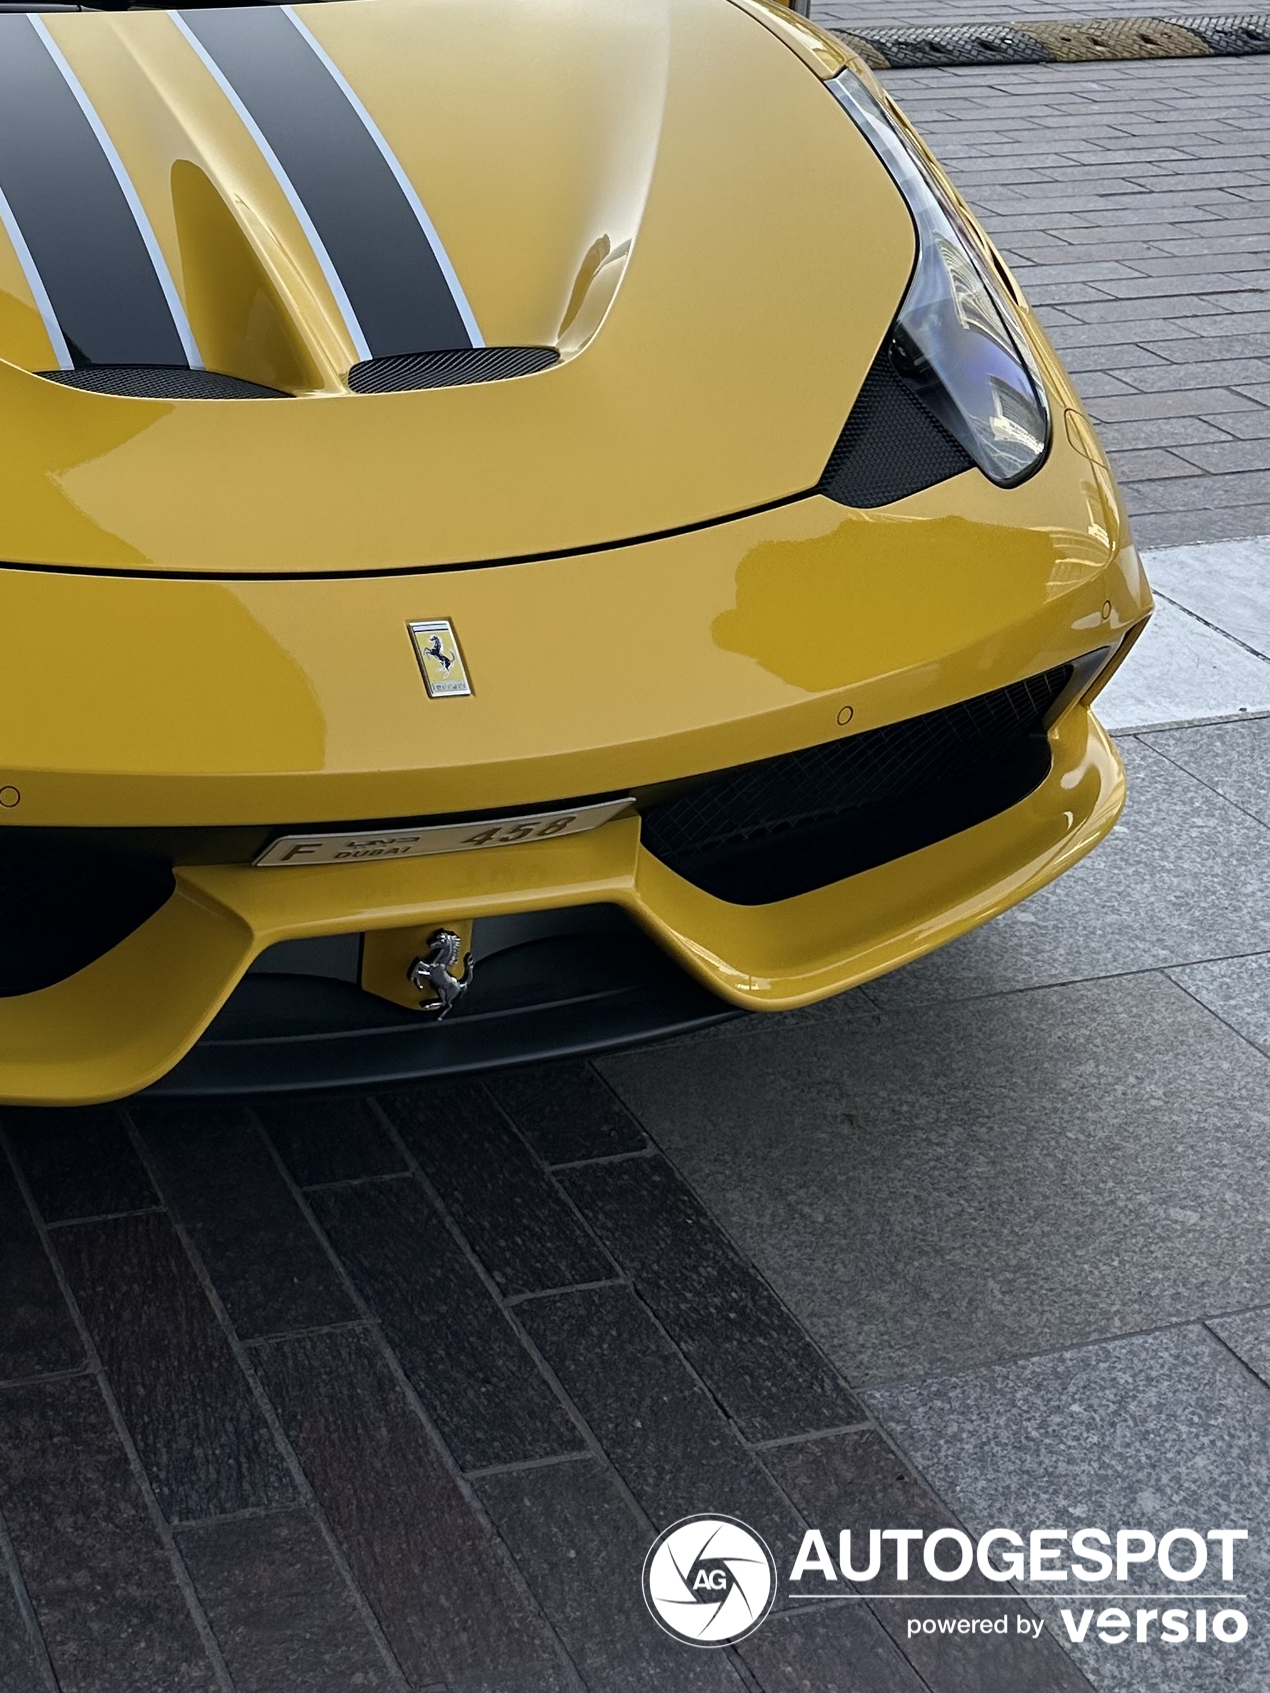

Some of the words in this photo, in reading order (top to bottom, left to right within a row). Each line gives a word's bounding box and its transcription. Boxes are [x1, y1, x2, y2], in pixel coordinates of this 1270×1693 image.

[281, 842, 324, 861] F
[333, 845, 412, 860] DUBAI
[460, 815, 577, 847] 458
